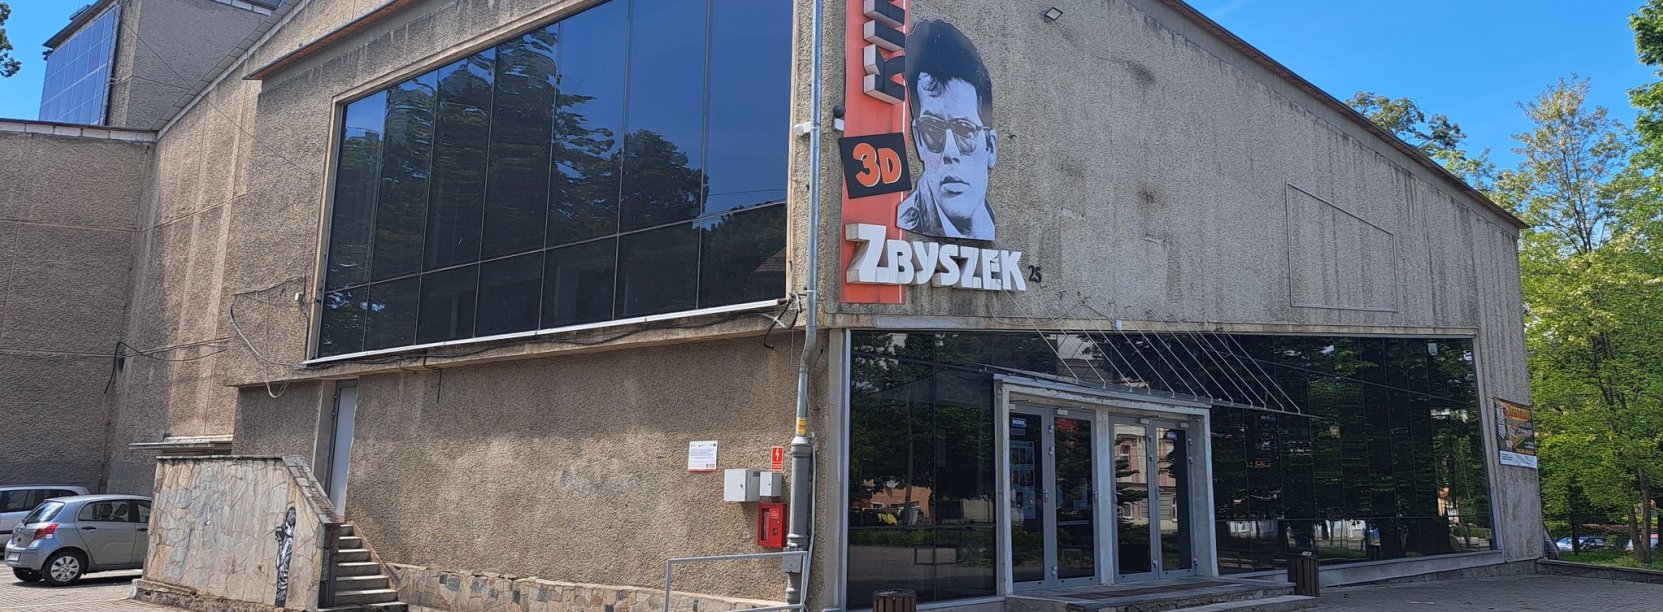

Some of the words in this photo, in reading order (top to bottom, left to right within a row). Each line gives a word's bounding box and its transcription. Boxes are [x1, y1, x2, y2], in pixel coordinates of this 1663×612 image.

[852, 142, 902, 188] 3D
[845, 223, 1027, 291] ZBYSZEK
[1027, 265, 1043, 284] 25
